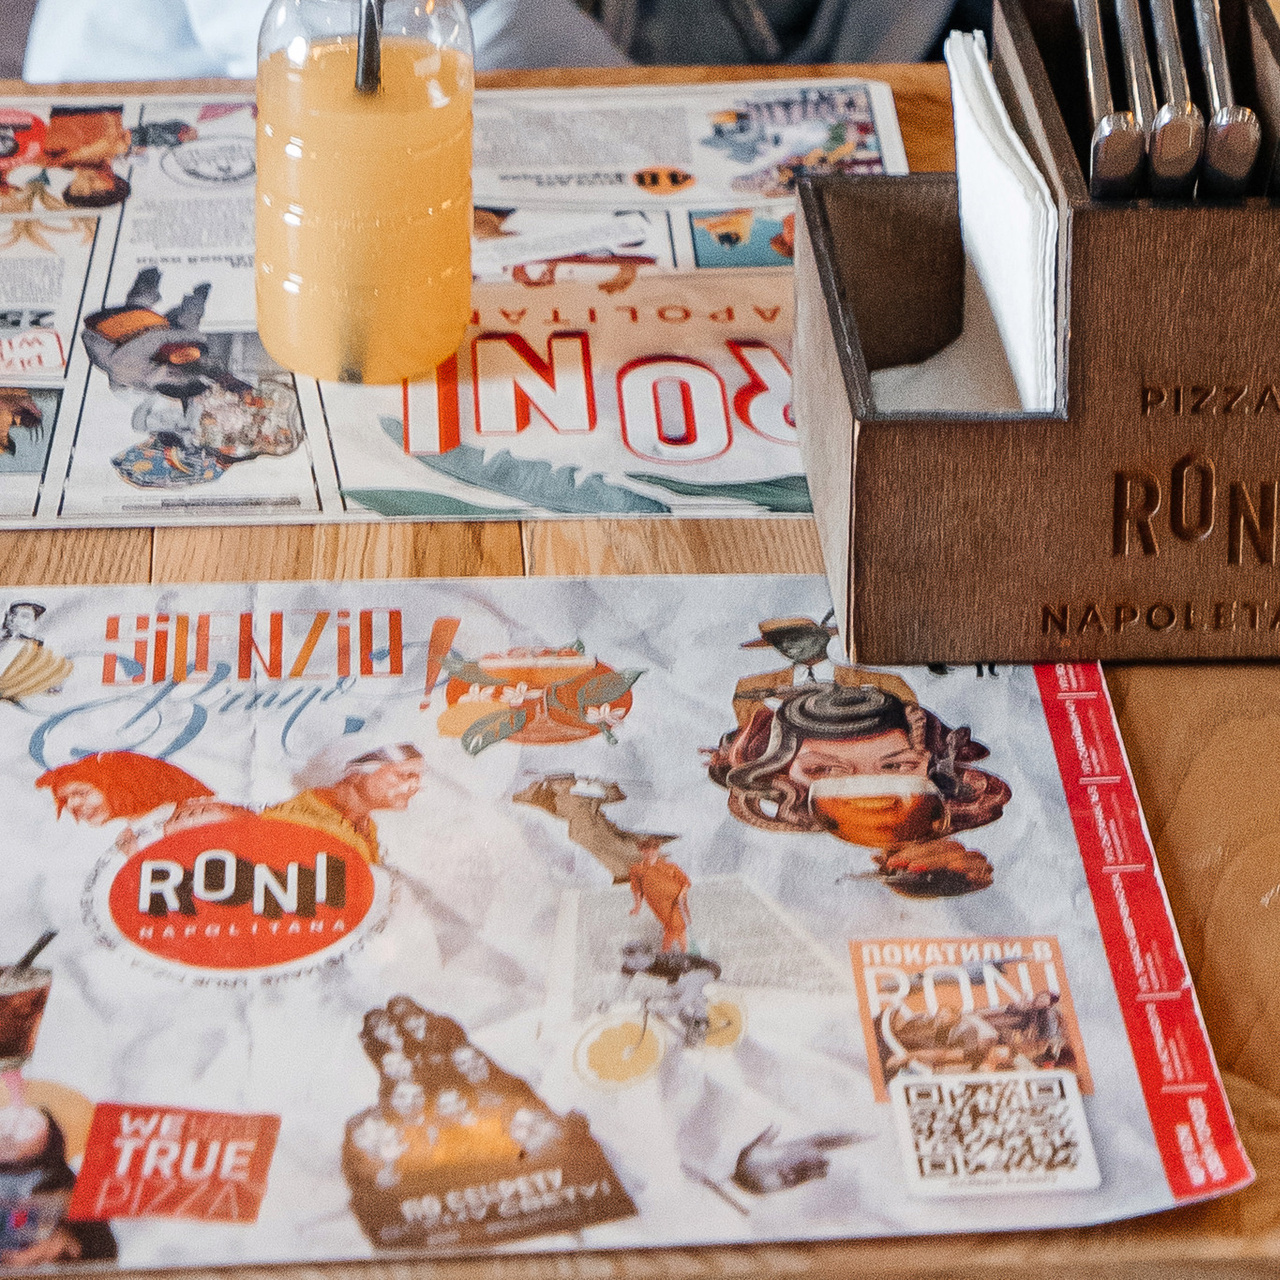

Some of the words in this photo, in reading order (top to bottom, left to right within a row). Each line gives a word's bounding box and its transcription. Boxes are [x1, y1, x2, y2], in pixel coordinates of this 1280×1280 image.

[470, 305, 782, 327] APOLITA
[138, 849, 345, 918] RONI
[138, 919, 346, 939] NAPOLITANA
[863, 962, 1060, 1019] RONI
[113, 1137, 256, 1181] TRUE
[94, 1176, 242, 1220] PIZZA
